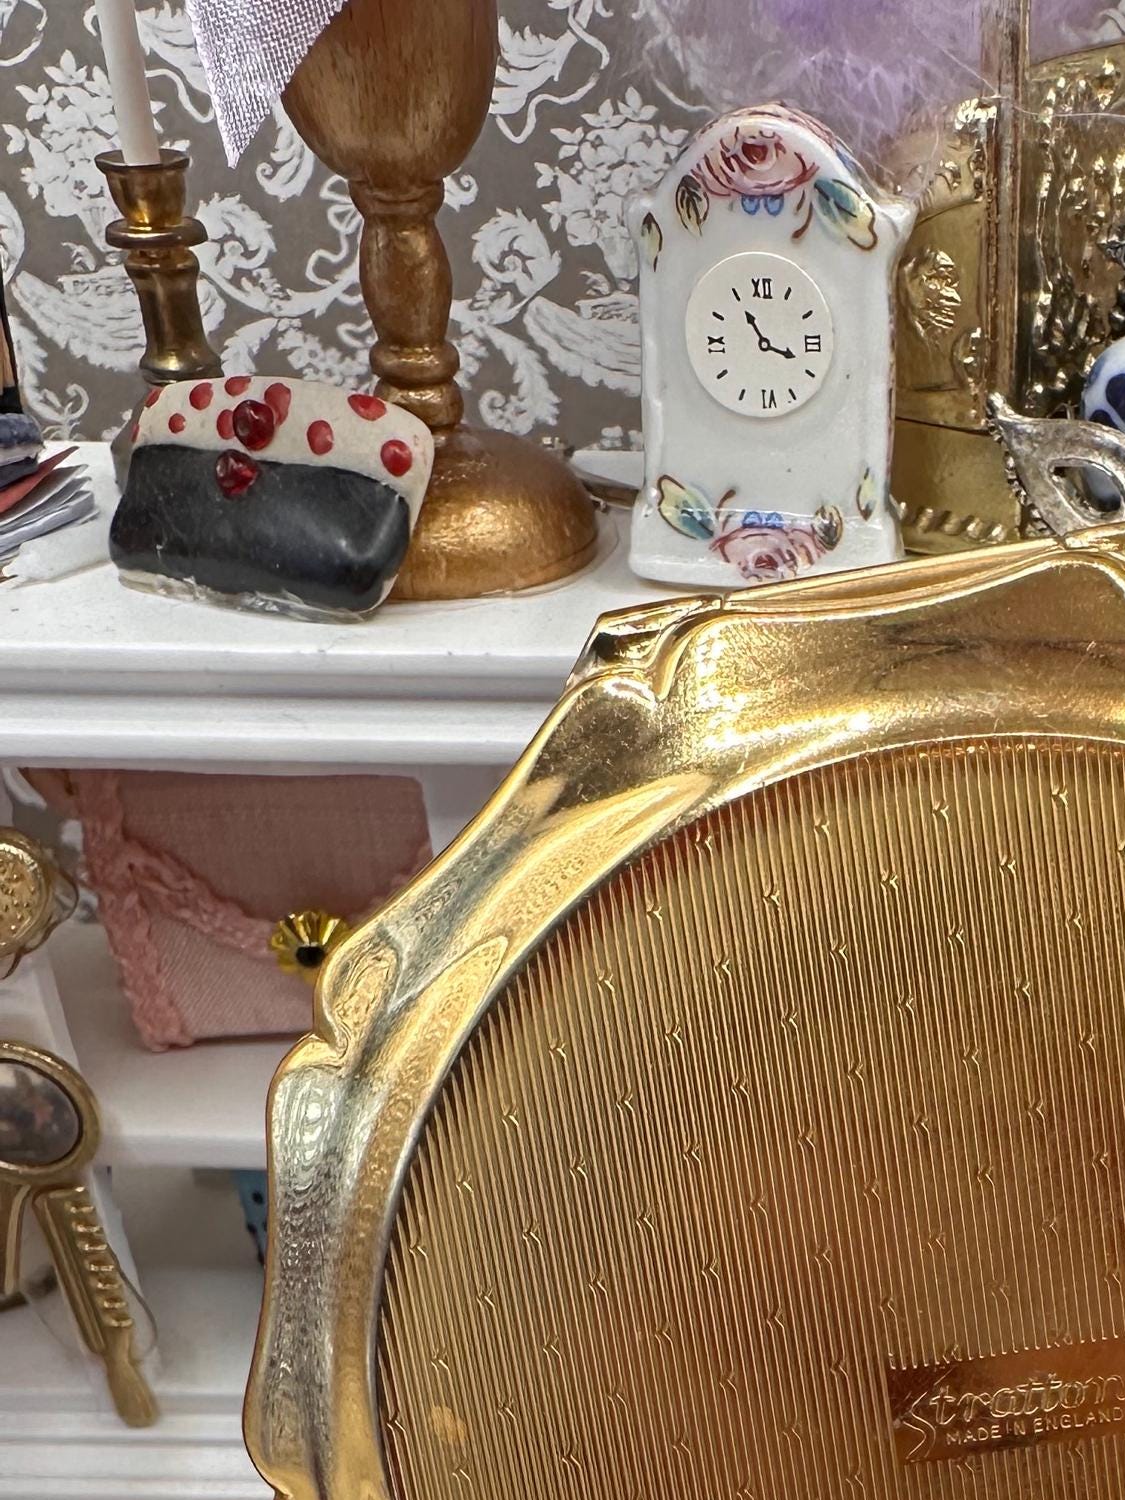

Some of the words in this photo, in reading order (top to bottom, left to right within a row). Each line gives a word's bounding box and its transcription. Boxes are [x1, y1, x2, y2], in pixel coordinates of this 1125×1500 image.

[751, 278, 773, 299] XII
[707, 335, 726, 354] IX
[945, 1425, 1002, 1446] MADE
[1005, 1419, 1026, 1437] IN
[1033, 1406, 1124, 1433] ENGLAND
